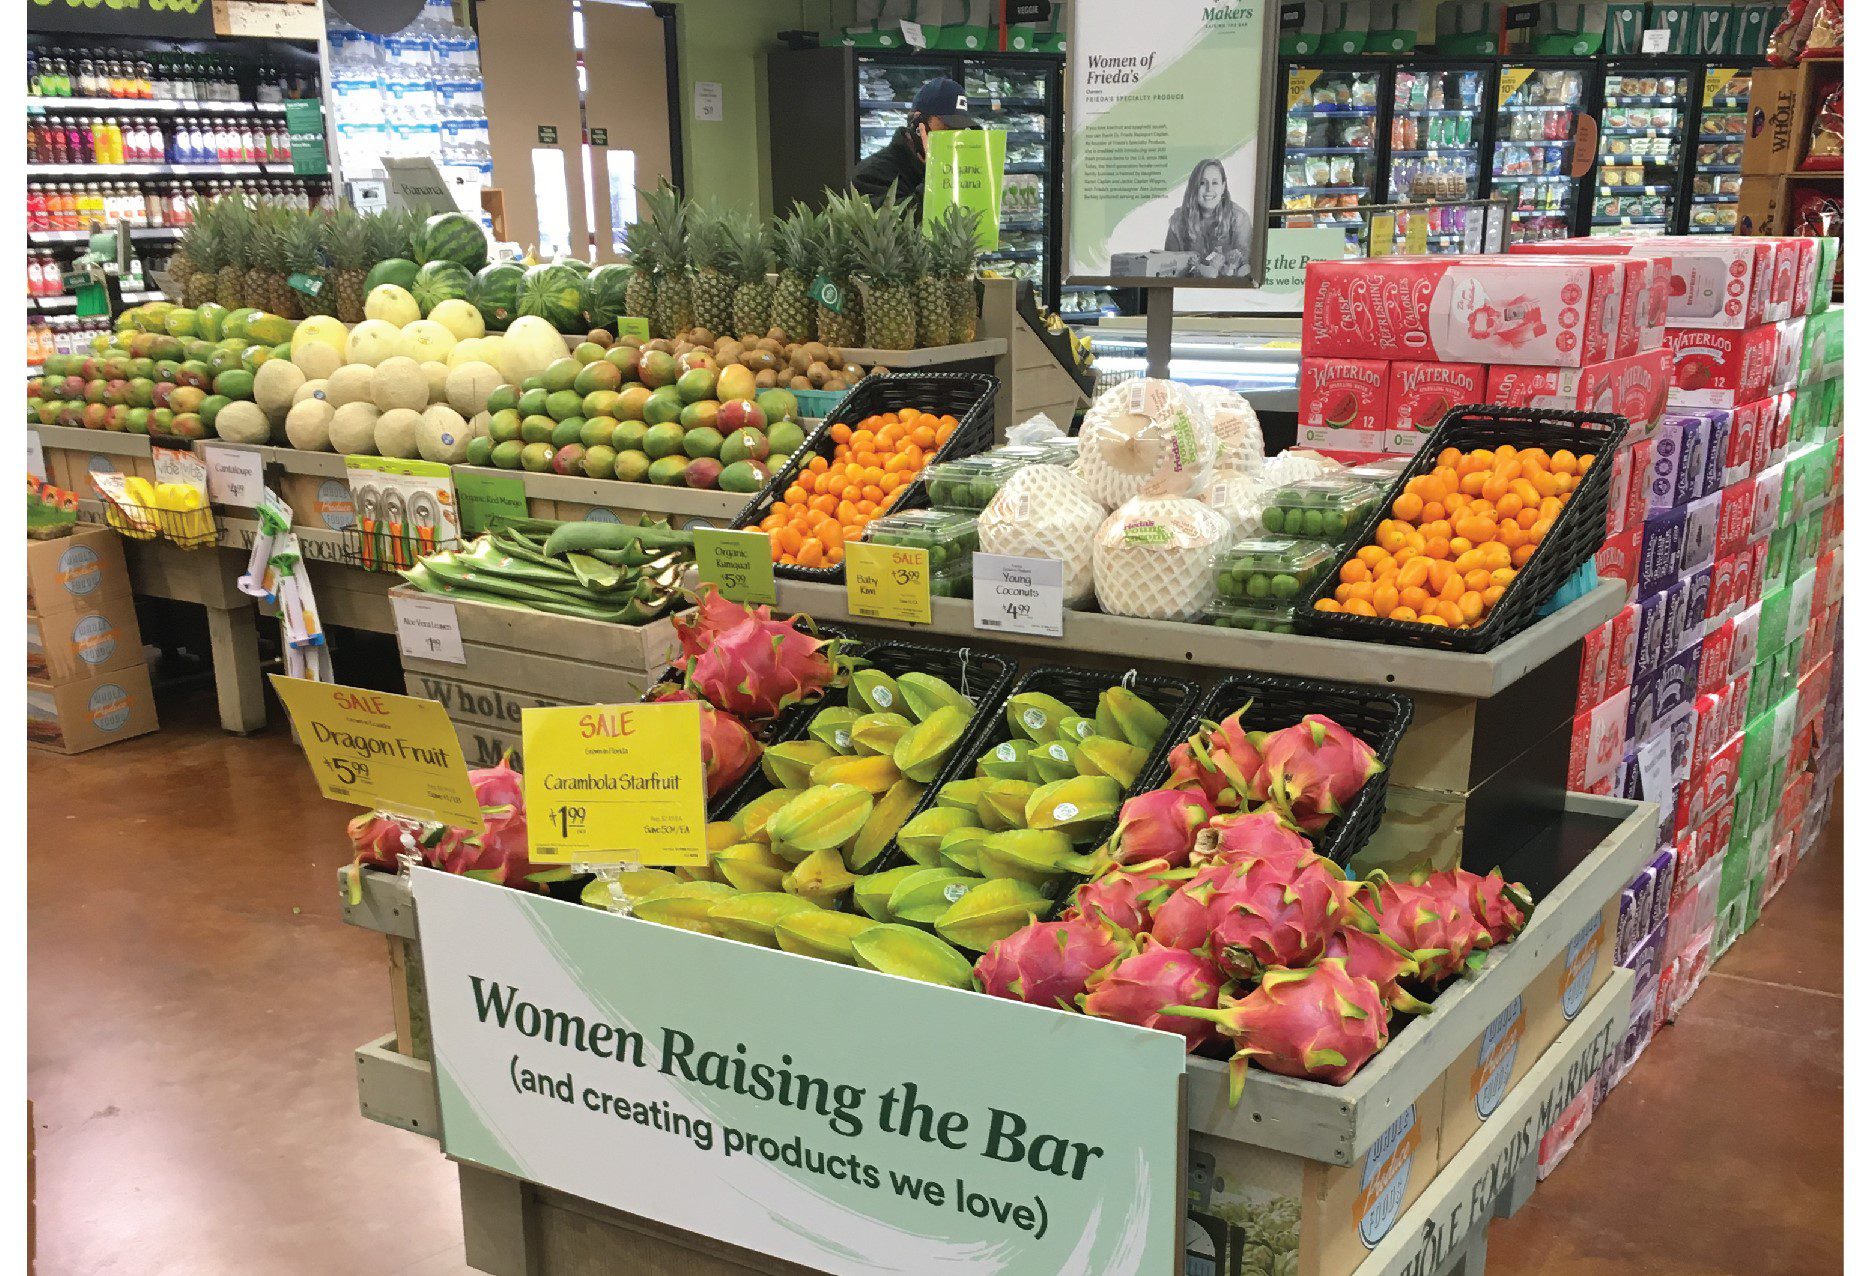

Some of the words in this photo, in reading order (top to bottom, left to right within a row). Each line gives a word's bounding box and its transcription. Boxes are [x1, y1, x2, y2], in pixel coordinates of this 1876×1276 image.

[1017, 6, 1039, 14] VEGGIE
[1202, 7, 1253, 21] Makers
[1088, 55, 1137, 68] Women
[1140, 52, 1156, 70] of
[1086, 70, 1139, 84] Frieda's
[1772, 90, 1796, 154] WHOLE
[401, 184, 443, 196] Banana
[943, 178, 981, 189] Baana
[1274, 254, 1296, 270] the
[1292, 277, 1306, 285] lov
[1312, 280, 1331, 345] WATERLOO
[1367, 274, 1398, 349] REFRESHING
[1400, 277, 1421, 330] CALORIES
[1662, 330, 1732, 352] WATERLOO
[1307, 361, 1381, 391] WATERLOO
[1397, 363, 1474, 395] WATERLOO
[1714, 377, 1725, 387] 12
[1363, 416, 1374, 428] 12
[214, 463, 252, 476] Cantaloupe
[500, 496, 523, 507] Mango
[715, 546, 747, 559] Organic
[892, 551, 924, 566] SALE
[856, 573, 879, 588] Baby
[1003, 571, 1032, 587] Young
[996, 585, 1040, 598] Coconuts
[333, 691, 391, 715] SALE
[421, 677, 521, 723] Whole
[579, 710, 637, 739] SALE
[310, 720, 396, 759] Dragon
[395, 738, 450, 769] Fruit
[543, 773, 617, 791] Carambola
[618, 771, 682, 791] Starfruit
[468, 975, 647, 1068] Women
[657, 1026, 867, 1138] Raising
[878, 1081, 969, 1151] the
[980, 1106, 1105, 1181] Bar
[1469, 1116, 1533, 1230] FOODS
[1535, 1016, 1615, 1142] MARKET
[1372, 1106, 1411, 1163] WHOLE
[510, 1054, 575, 1105] (and
[582, 1086, 714, 1152] creating
[722, 1125, 881, 1190] products
[889, 1169, 946, 1208] we
[956, 1178, 1049, 1241] love)
[1368, 1180, 1404, 1238] FOODS
